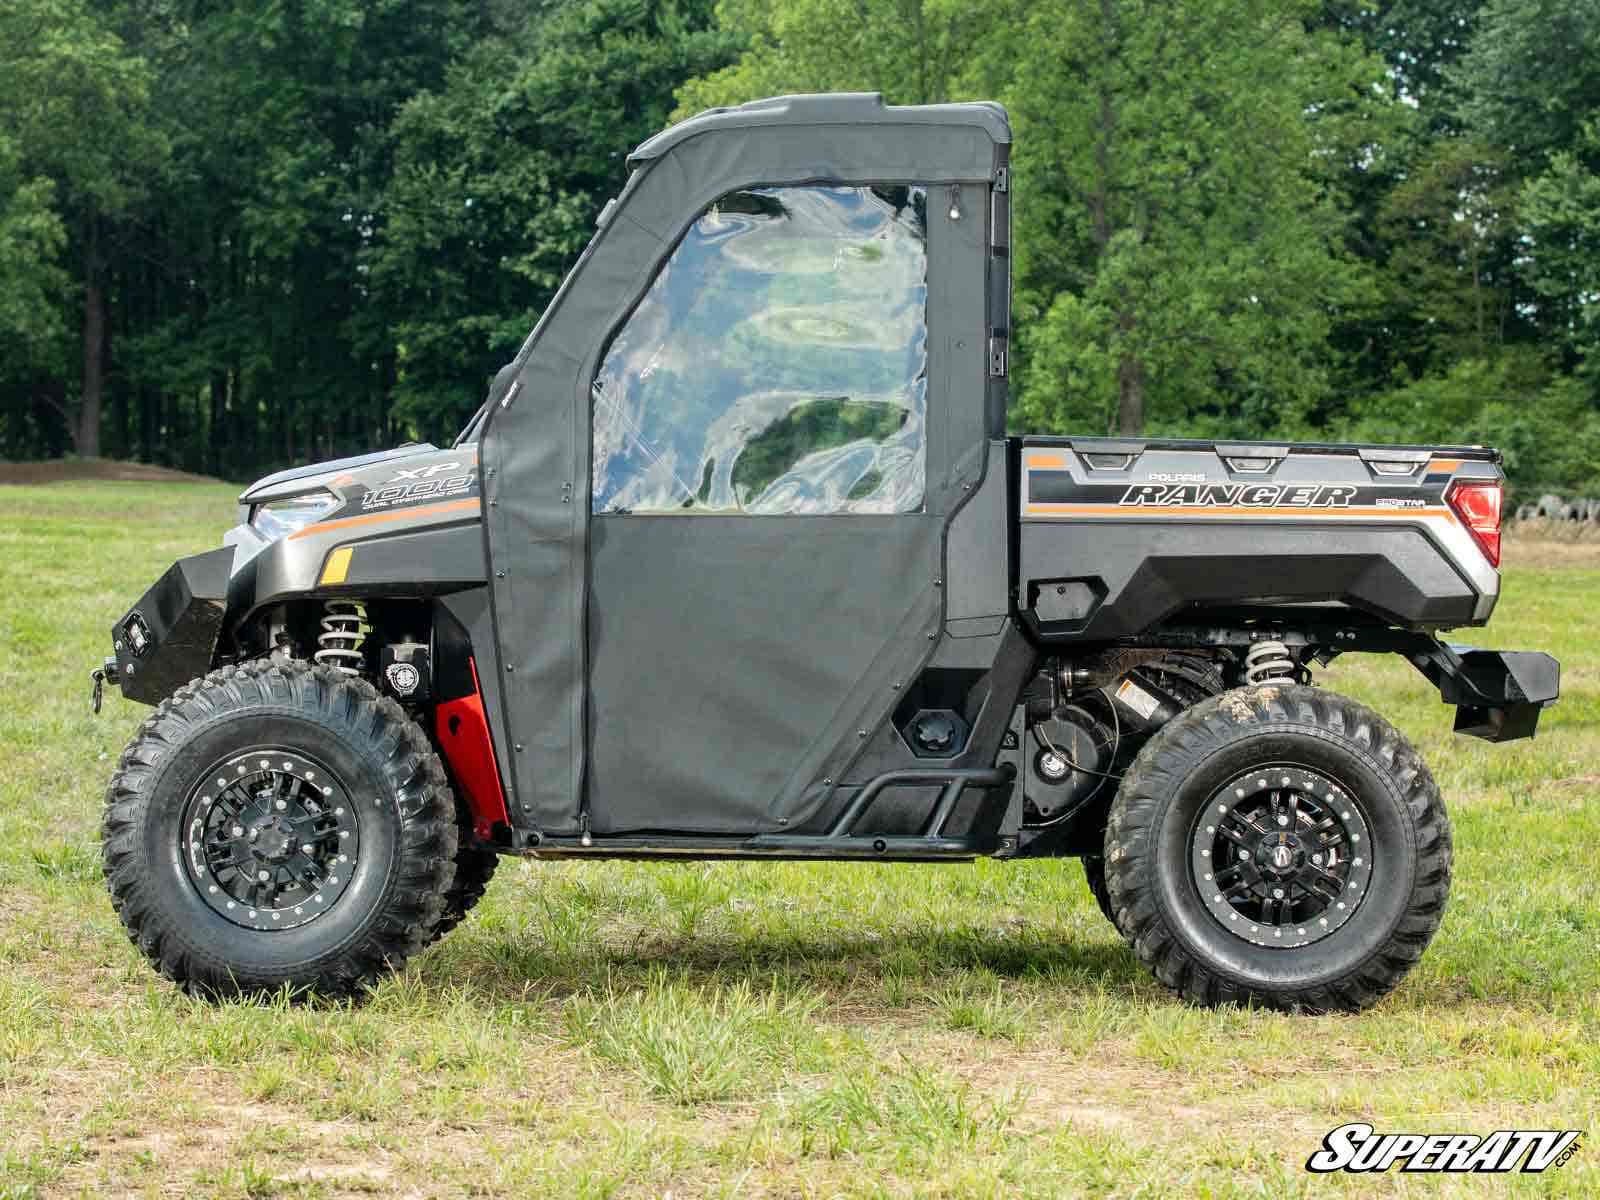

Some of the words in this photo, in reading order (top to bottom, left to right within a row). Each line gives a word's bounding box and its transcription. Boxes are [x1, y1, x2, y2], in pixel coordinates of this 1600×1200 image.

[390, 462, 461, 482] XP
[1147, 472, 1207, 482] POLARIS
[361, 473, 475, 505] 1000
[1119, 484, 1358, 508] RANGER
[1375, 498, 1425, 507] PROSTAR
